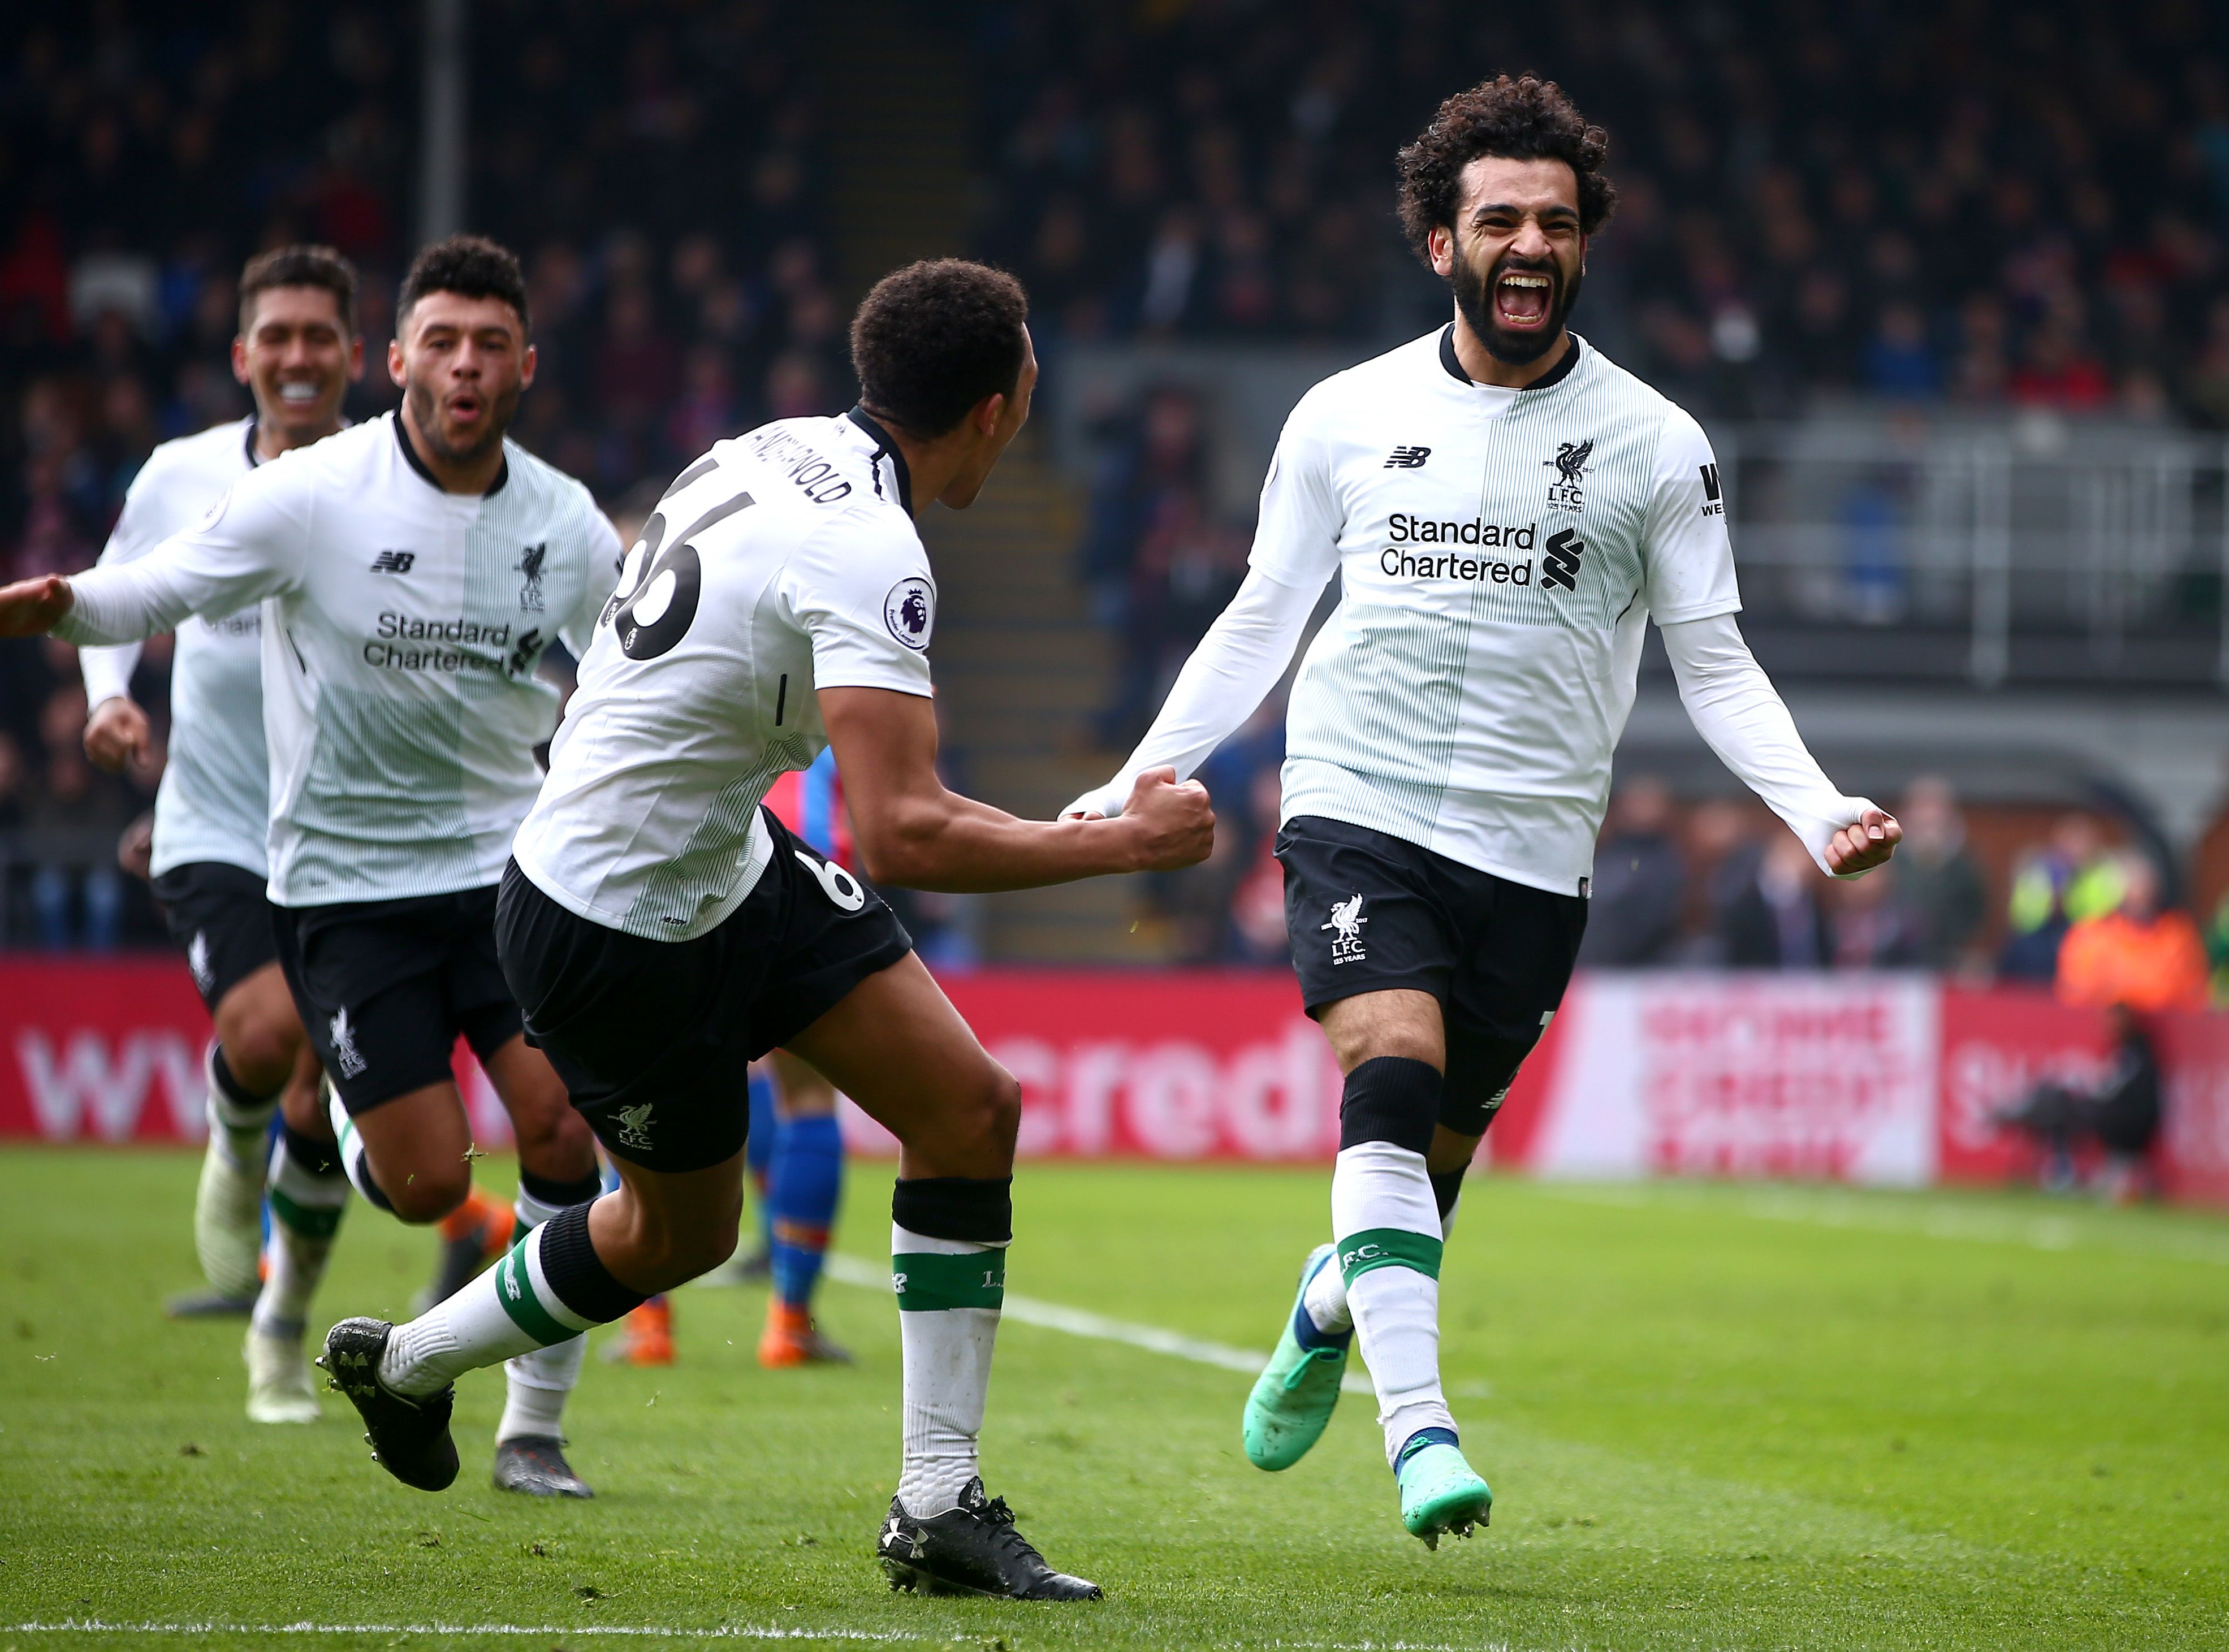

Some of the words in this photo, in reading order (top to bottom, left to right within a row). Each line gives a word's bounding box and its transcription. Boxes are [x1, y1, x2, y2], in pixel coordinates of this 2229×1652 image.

[1383, 446, 1432, 469] NB
[1560, 504, 1583, 513] YEARS
[1701, 503, 1723, 517] WE
[1389, 513, 1536, 551] Standard
[370, 551, 415, 573] NB
[600, 457, 757, 661] 66
[1380, 548, 1532, 587] Chartered
[376, 613, 509, 647] Standard
[363, 643, 504, 672] Chartered
[794, 850, 865, 911] 6
[1344, 954, 1366, 962] YEARS
[988, 1018, 1341, 1158] cred
